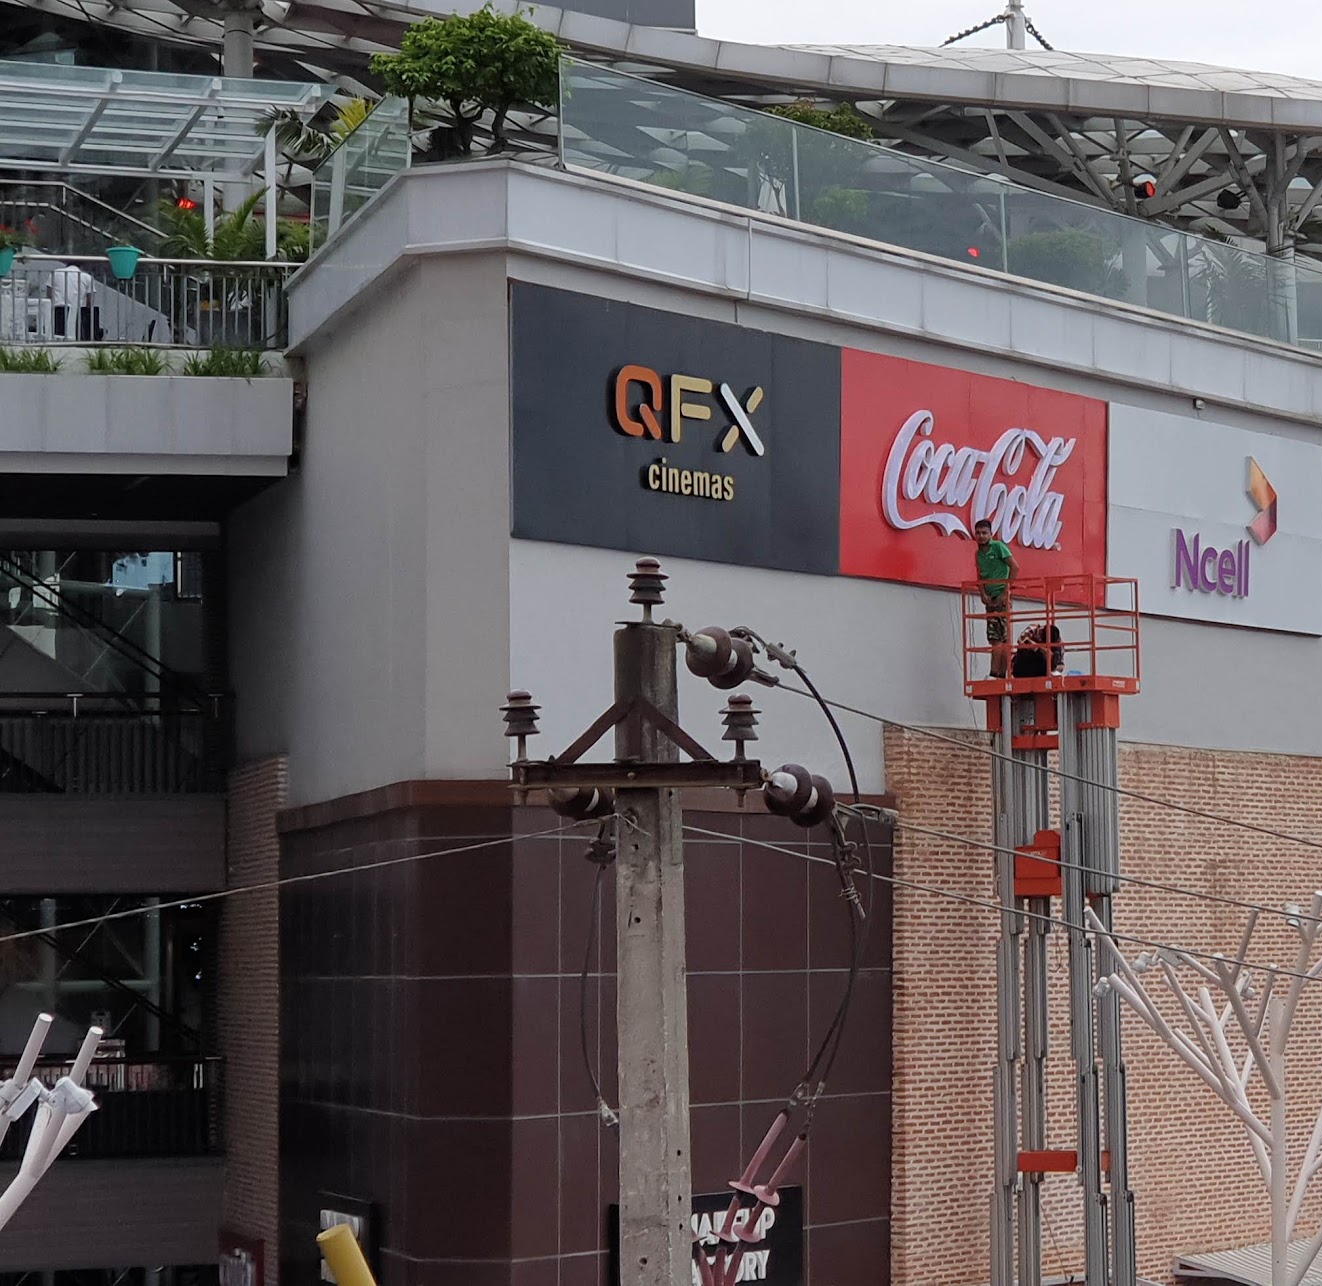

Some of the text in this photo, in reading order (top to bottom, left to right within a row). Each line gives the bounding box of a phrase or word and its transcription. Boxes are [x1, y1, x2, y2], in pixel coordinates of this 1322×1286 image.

[616, 365, 765, 457] QFX
[648, 457, 734, 500] cinemas
[1173, 528, 1250, 597] Ncell
